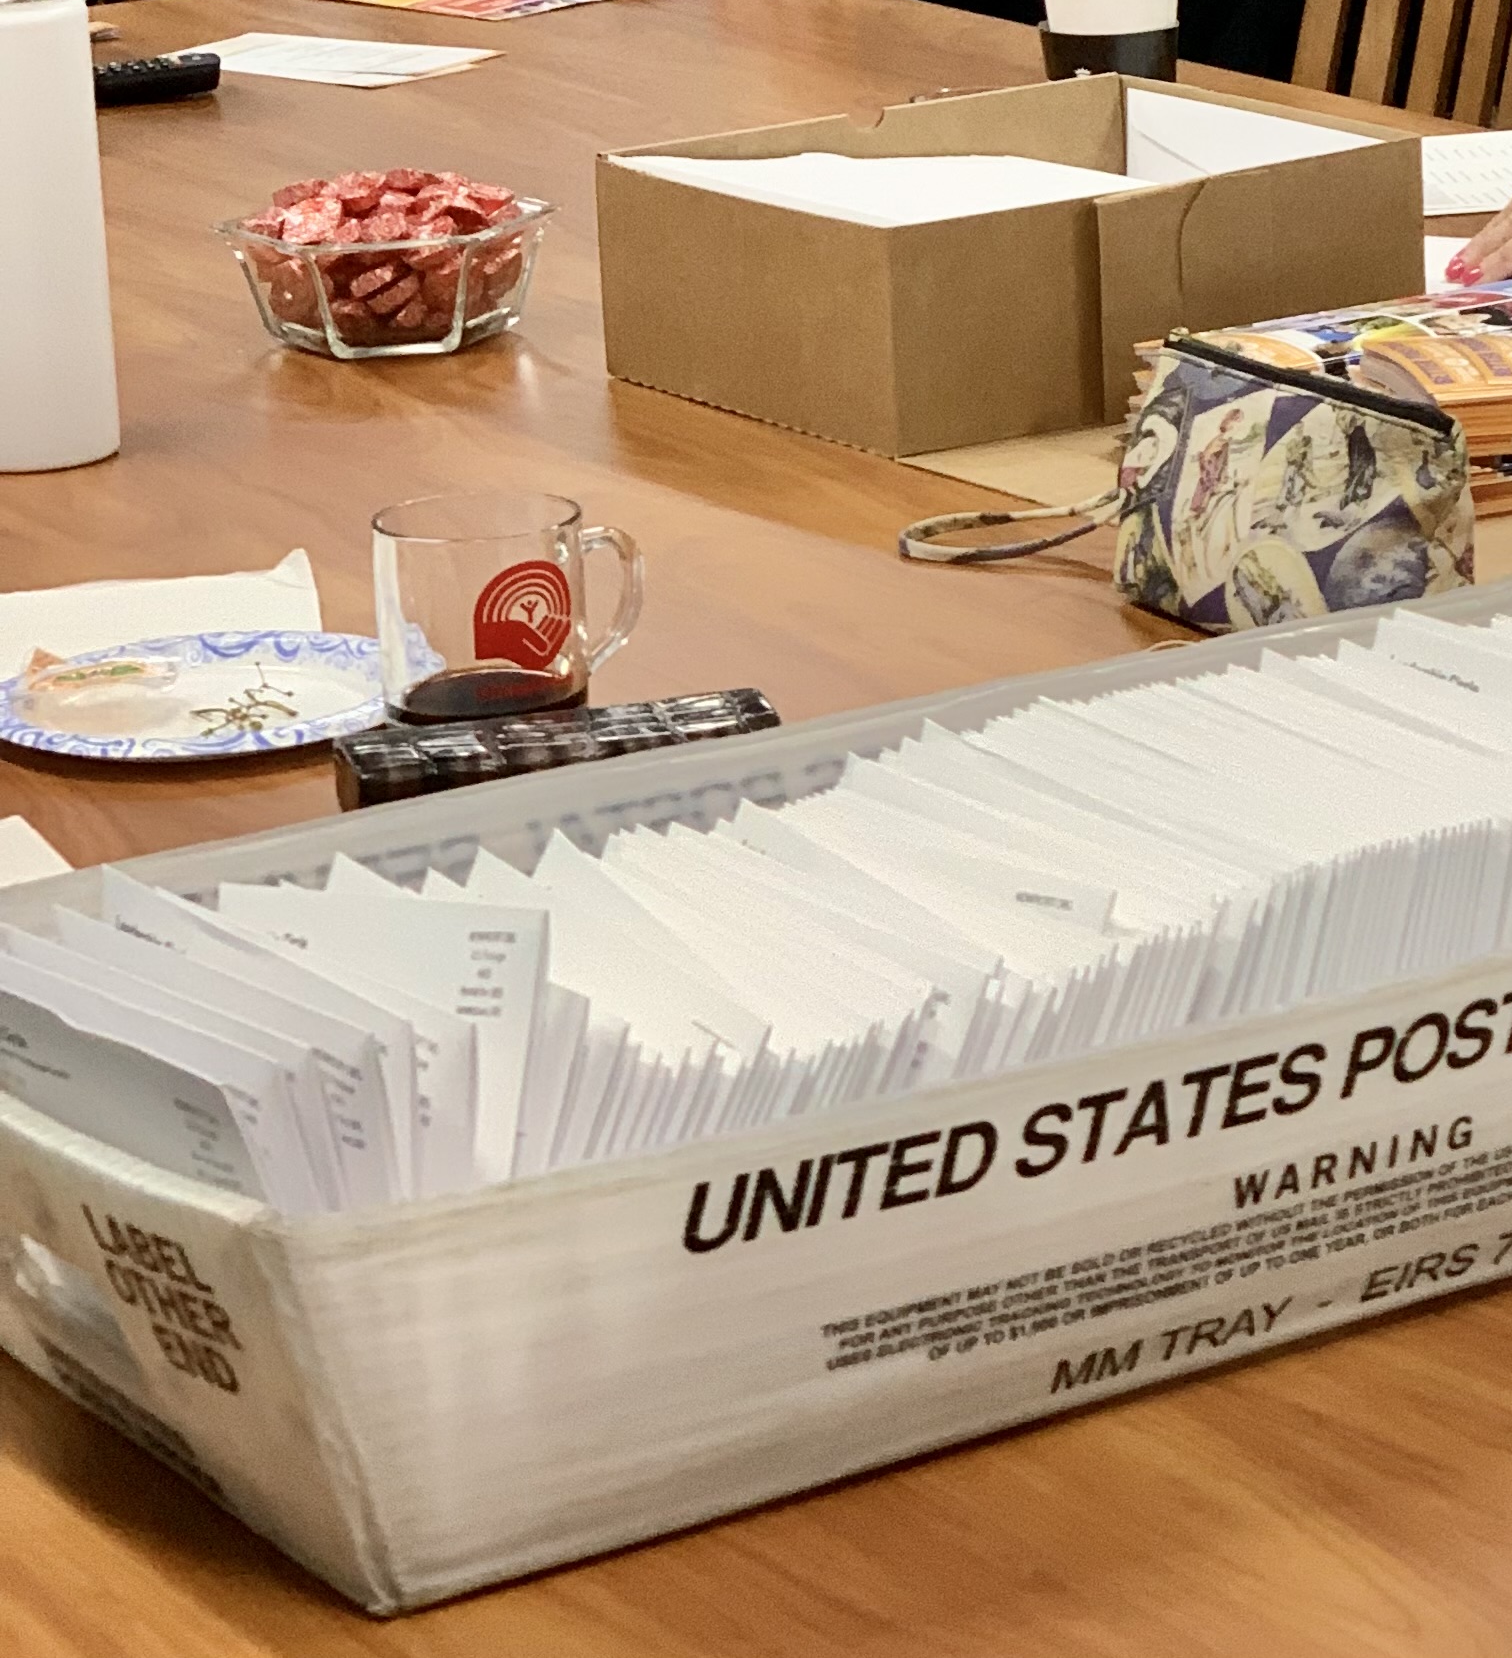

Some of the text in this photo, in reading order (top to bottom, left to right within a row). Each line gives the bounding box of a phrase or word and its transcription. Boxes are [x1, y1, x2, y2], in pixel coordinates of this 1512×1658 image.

[683, 1121, 998, 1254] UNITED
[1015, 1043, 1327, 1178] STATES
[1235, 1115, 1473, 1209] WARNING
[81, 1203, 214, 1295] LABEL
[105, 1260, 243, 1351] OTHER
[1052, 1342, 1140, 1393] MM
[1165, 1296, 1292, 1361] TRAY
[1361, 1245, 1476, 1303] EIRS
[152, 1322, 240, 1394] END
